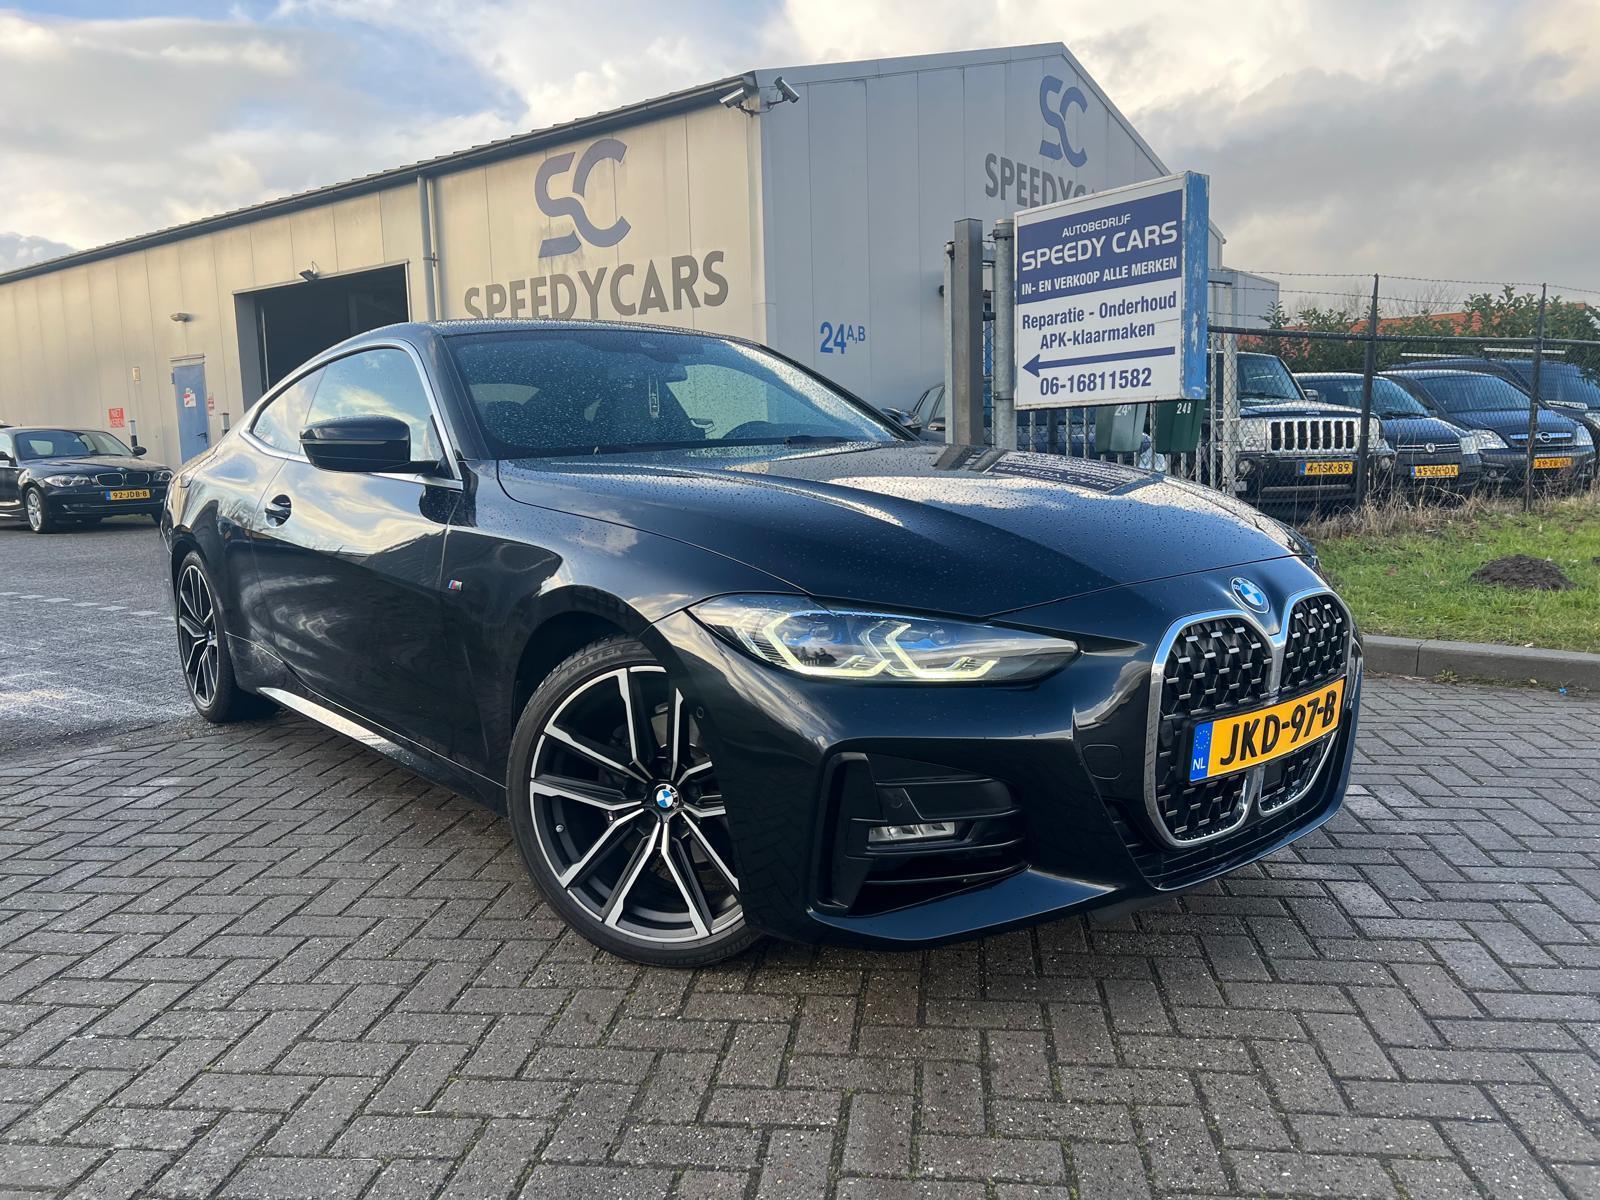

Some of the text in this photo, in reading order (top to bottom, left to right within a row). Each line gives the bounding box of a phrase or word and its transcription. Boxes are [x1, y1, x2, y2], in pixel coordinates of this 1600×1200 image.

[985, 152, 1096, 208] SPEEDY
[1021, 220, 1178, 271] SPEEDY CARS
[1062, 213, 1131, 238] AUTOBEDRIJF
[464, 250, 729, 321] SPEEDYCARS
[1021, 256, 1177, 296] IN- EN VERKOOP ALLE MERKEN
[1022, 306, 1085, 331] Reparatie
[1099, 291, 1177, 319] Onderhoud
[1040, 322, 1155, 350] APK-klaarmaken
[1040, 367, 1152, 396] 06-16811582
[112, 490, 148, 499] 92-JDB-8
[1220, 689, 1337, 766] JKD-97-B
[1192, 758, 1206, 770] NL
